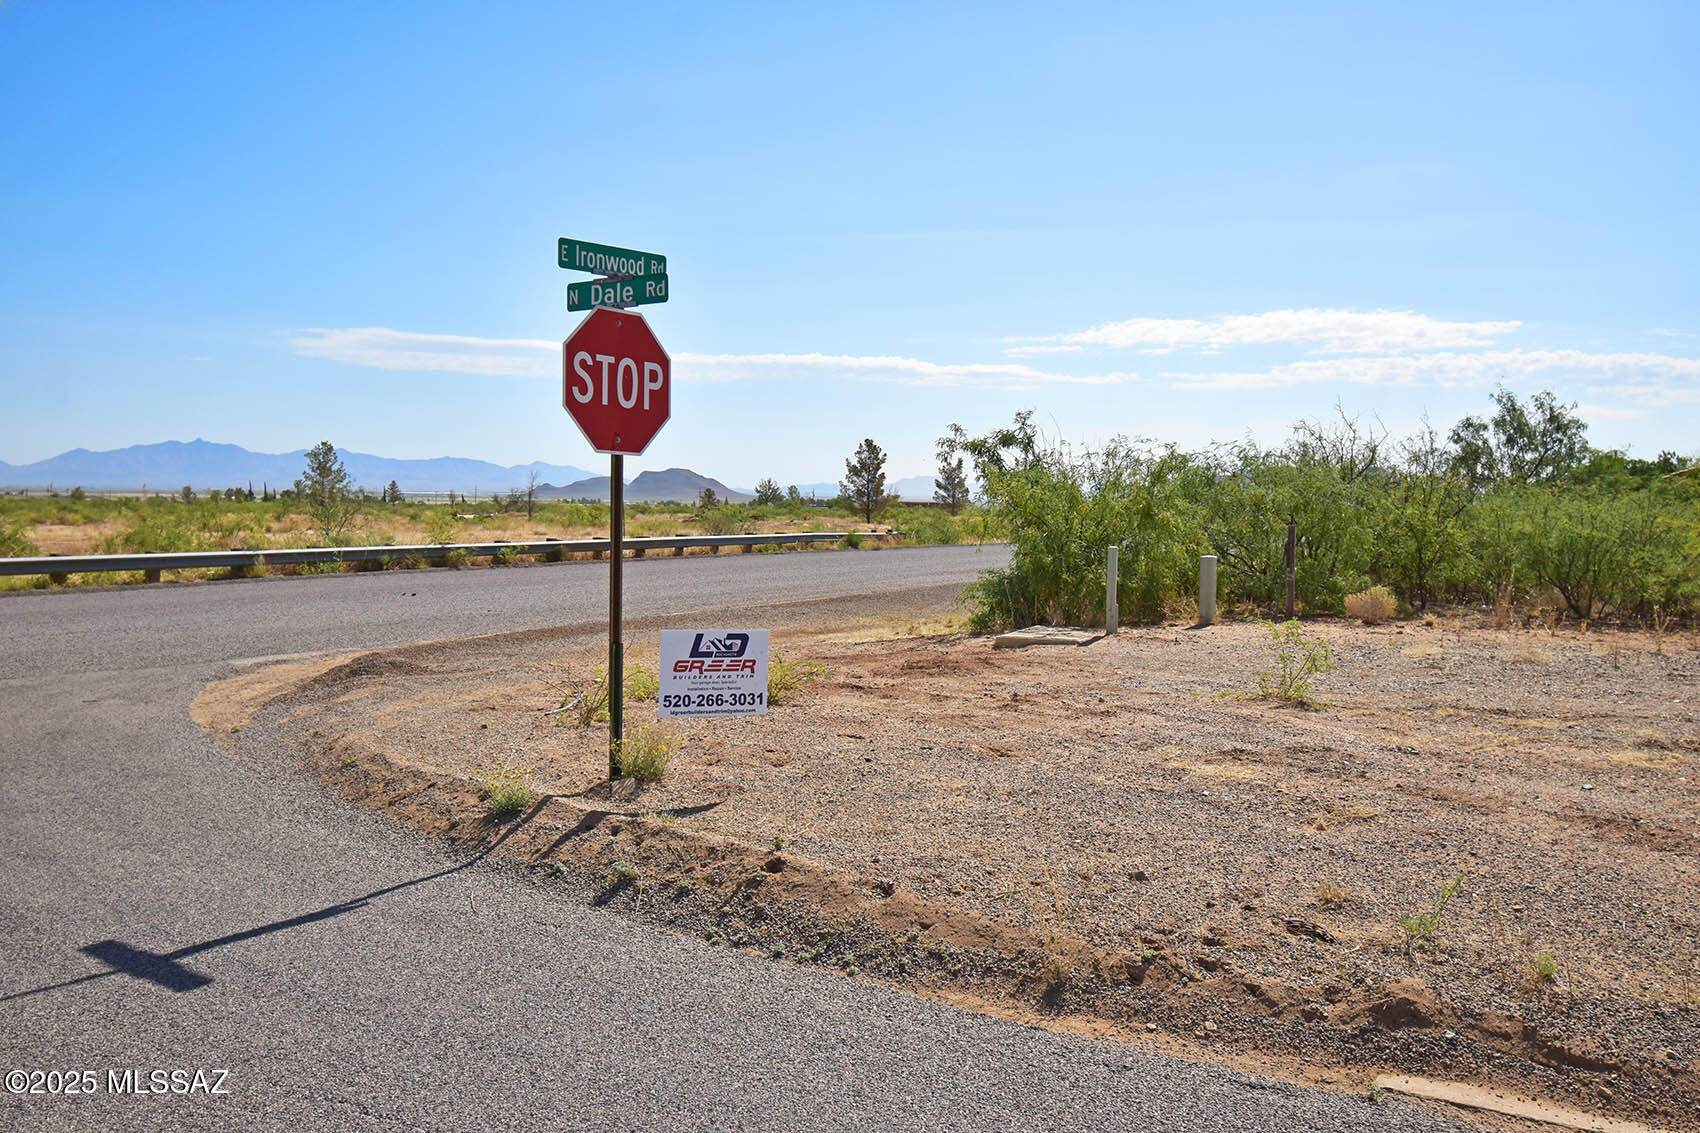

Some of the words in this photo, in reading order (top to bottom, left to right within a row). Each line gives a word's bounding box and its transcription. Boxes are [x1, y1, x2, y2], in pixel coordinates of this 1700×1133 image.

[561, 244, 569, 262] E
[575, 244, 645, 276] Ironwood
[650, 260, 665, 275] Rd
[569, 289, 579, 305] N
[591, 282, 634, 305] Dale
[646, 280, 666, 298] Rd
[572, 351, 664, 410] STOP
[673, 659, 757, 675] GREER
[663, 692, 763, 708] 520-266-3031
